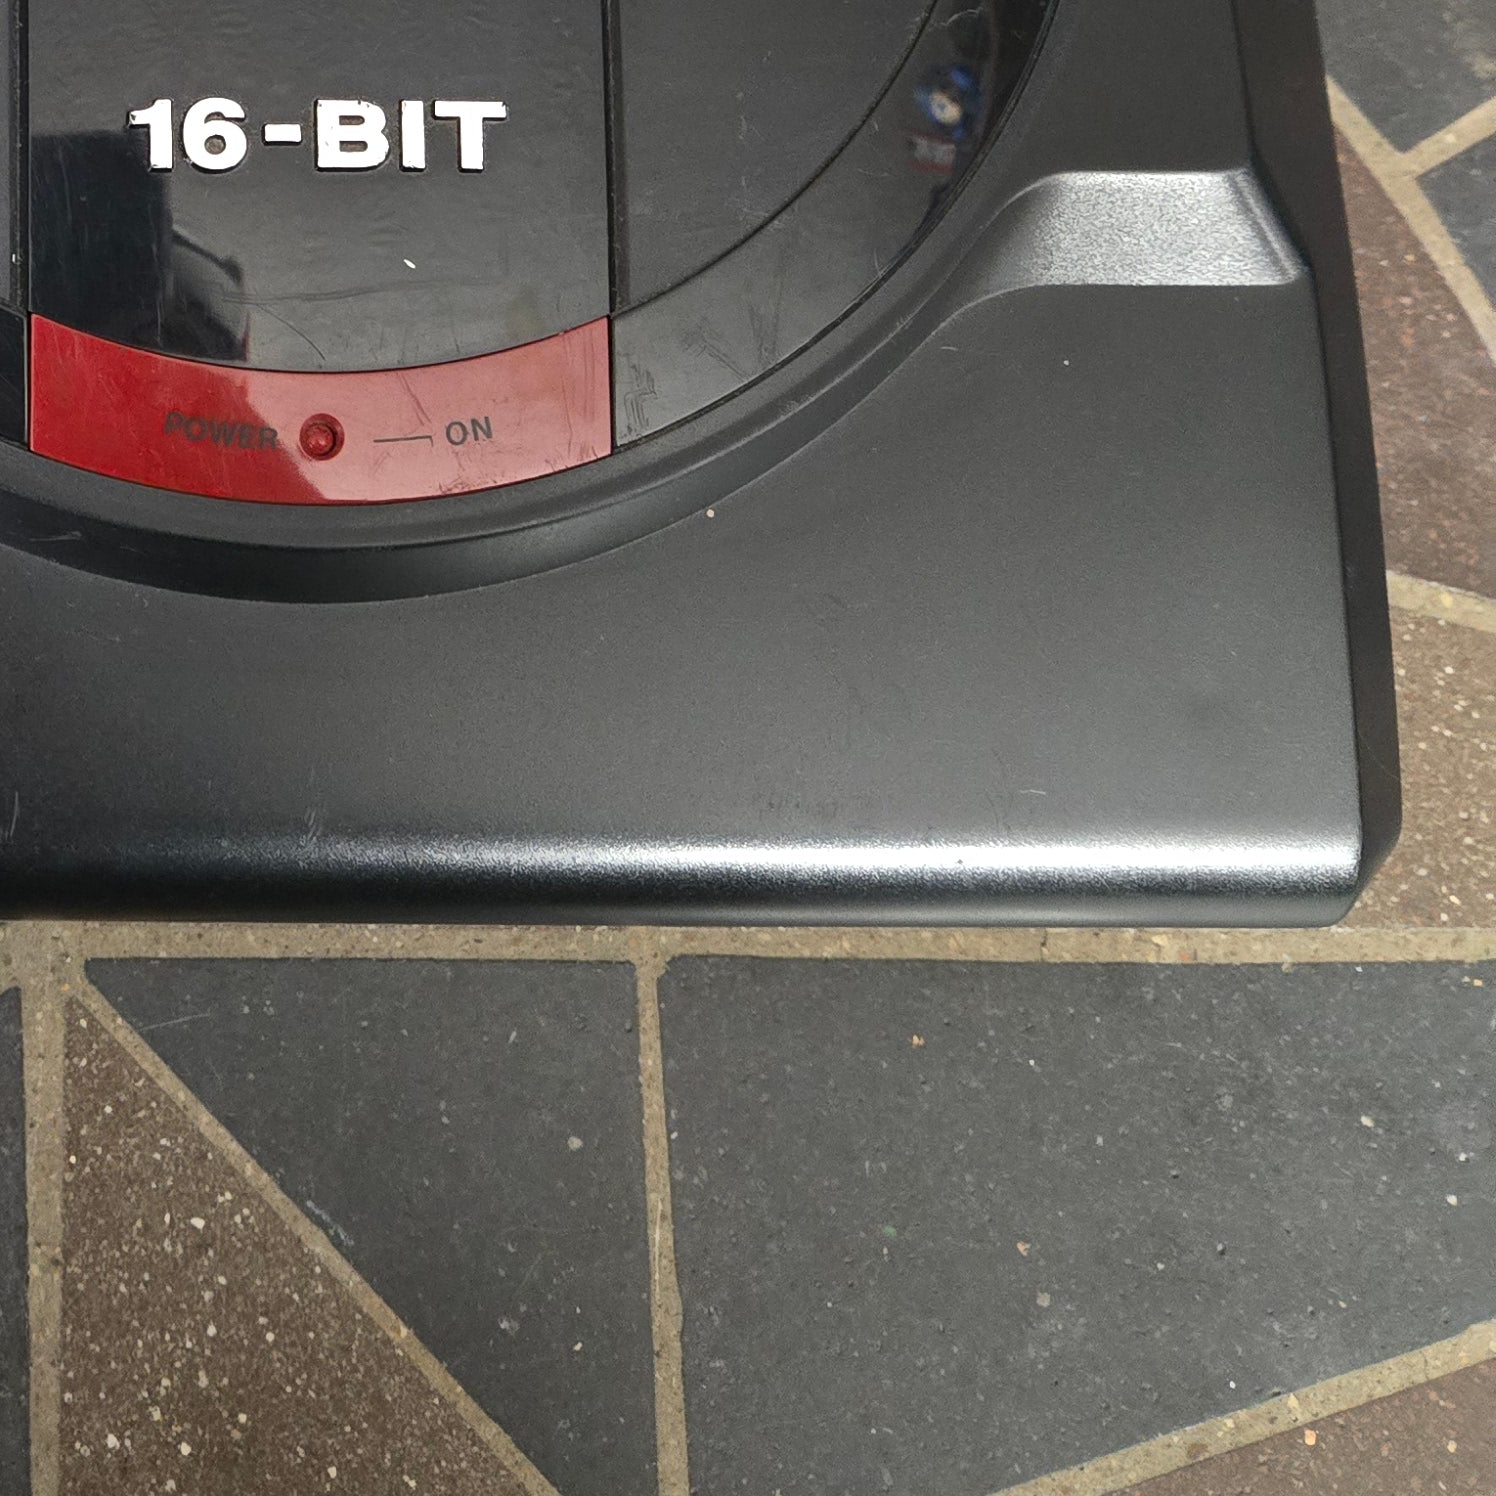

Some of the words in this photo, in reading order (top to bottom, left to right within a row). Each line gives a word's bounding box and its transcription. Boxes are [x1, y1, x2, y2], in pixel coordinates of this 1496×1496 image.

[128, 98, 507, 174] 16-BIT
[164, 411, 278, 451] POWER
[445, 415, 493, 446] ON
